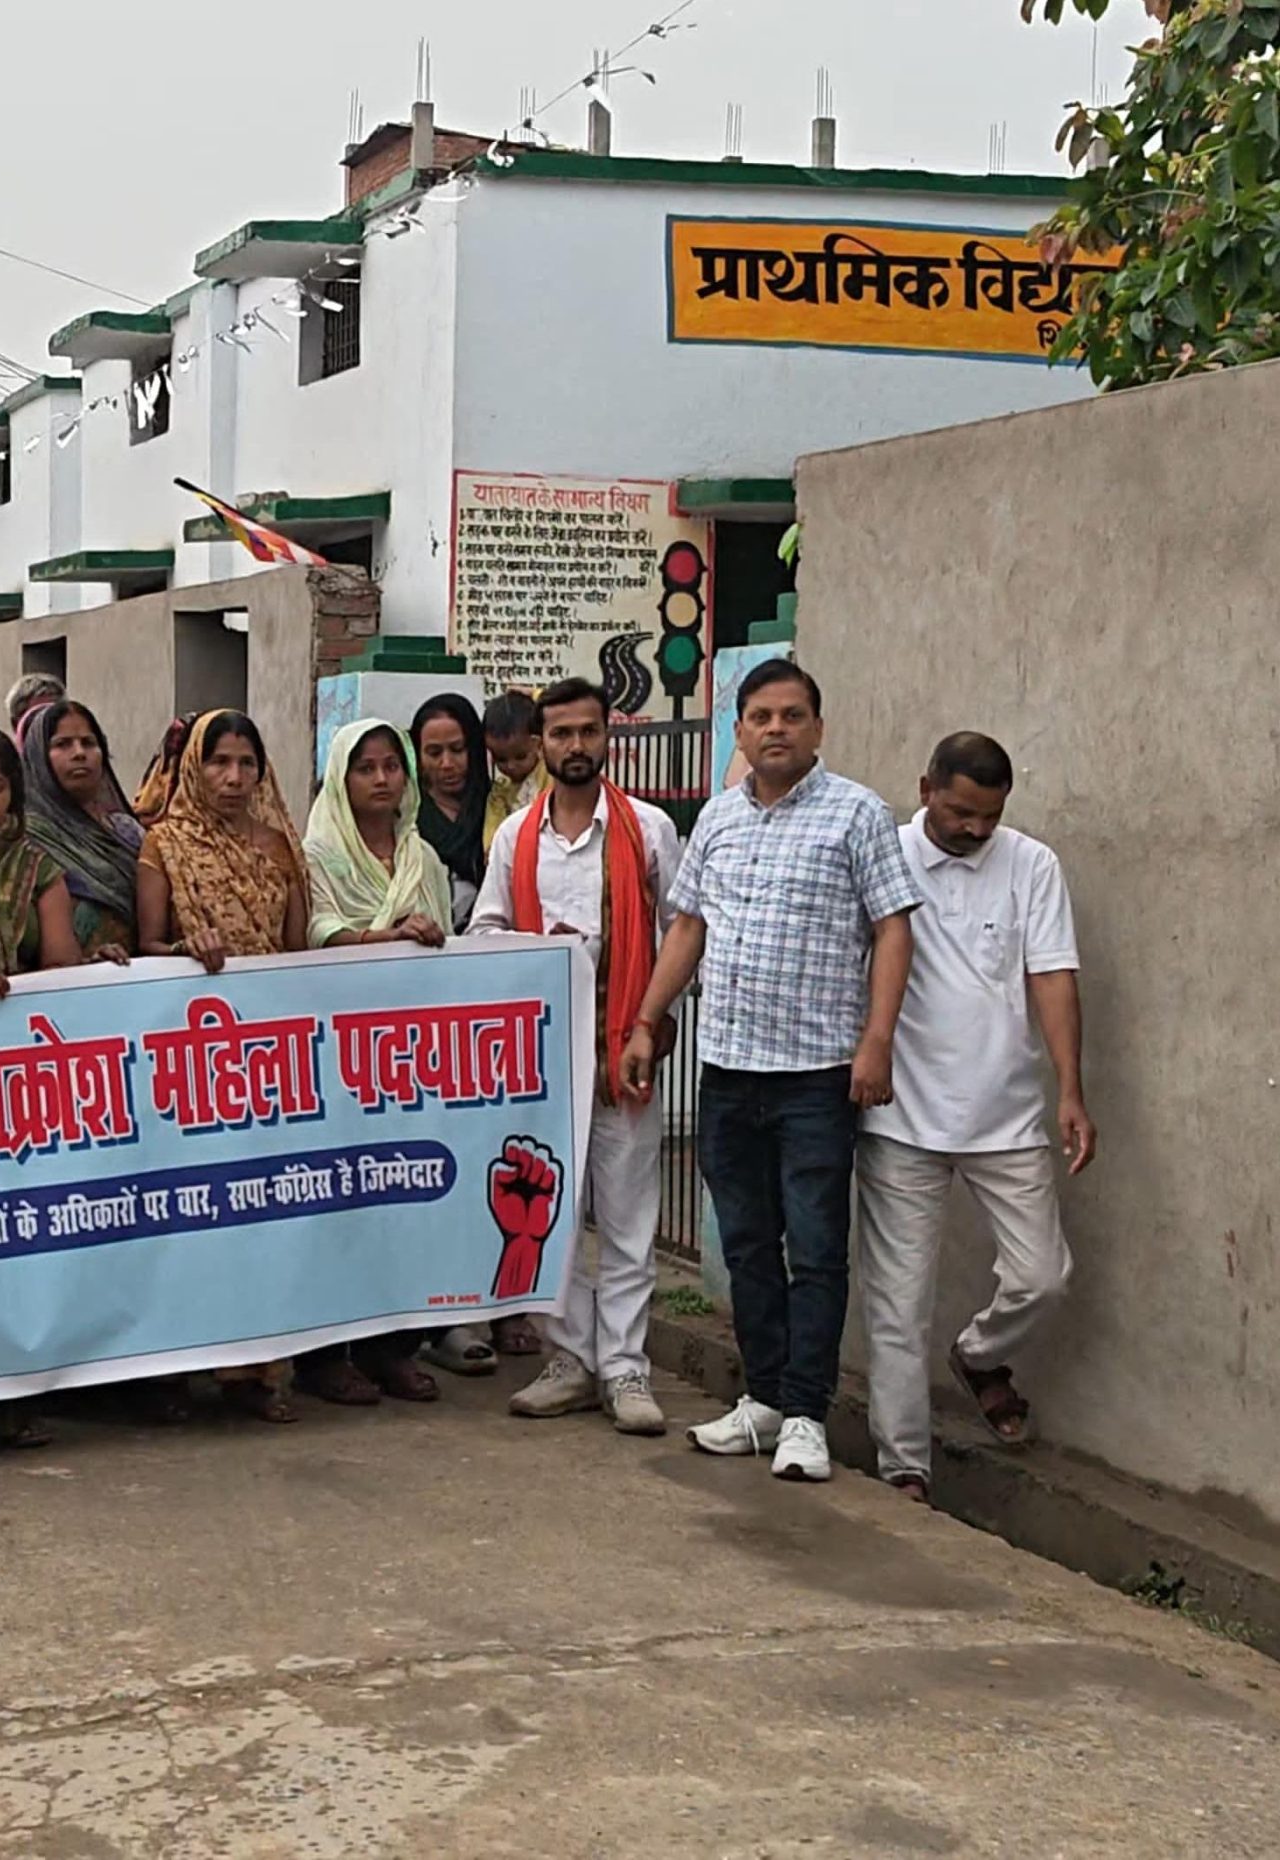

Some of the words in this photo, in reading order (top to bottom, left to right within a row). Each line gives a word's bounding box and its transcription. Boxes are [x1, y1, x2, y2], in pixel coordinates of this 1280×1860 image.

[690, 232, 951, 310] प्राथमिक
[955, 240, 1120, 316] विद्य
[472, 484, 536, 508] यातायात
[552, 488, 605, 511] सामान्य
[608, 486, 652, 514] नियम
[140, 995, 320, 1130] महिला
[330, 998, 548, 1113] पदयात्रा
[12, 1199, 39, 1241] के
[46, 1184, 138, 1237] अधिकारों
[142, 1188, 171, 1222] पर
[174, 1184, 219, 1221] वार,
[334, 1157, 355, 1197] है
[357, 1152, 447, 1194] जिम्मेदार
